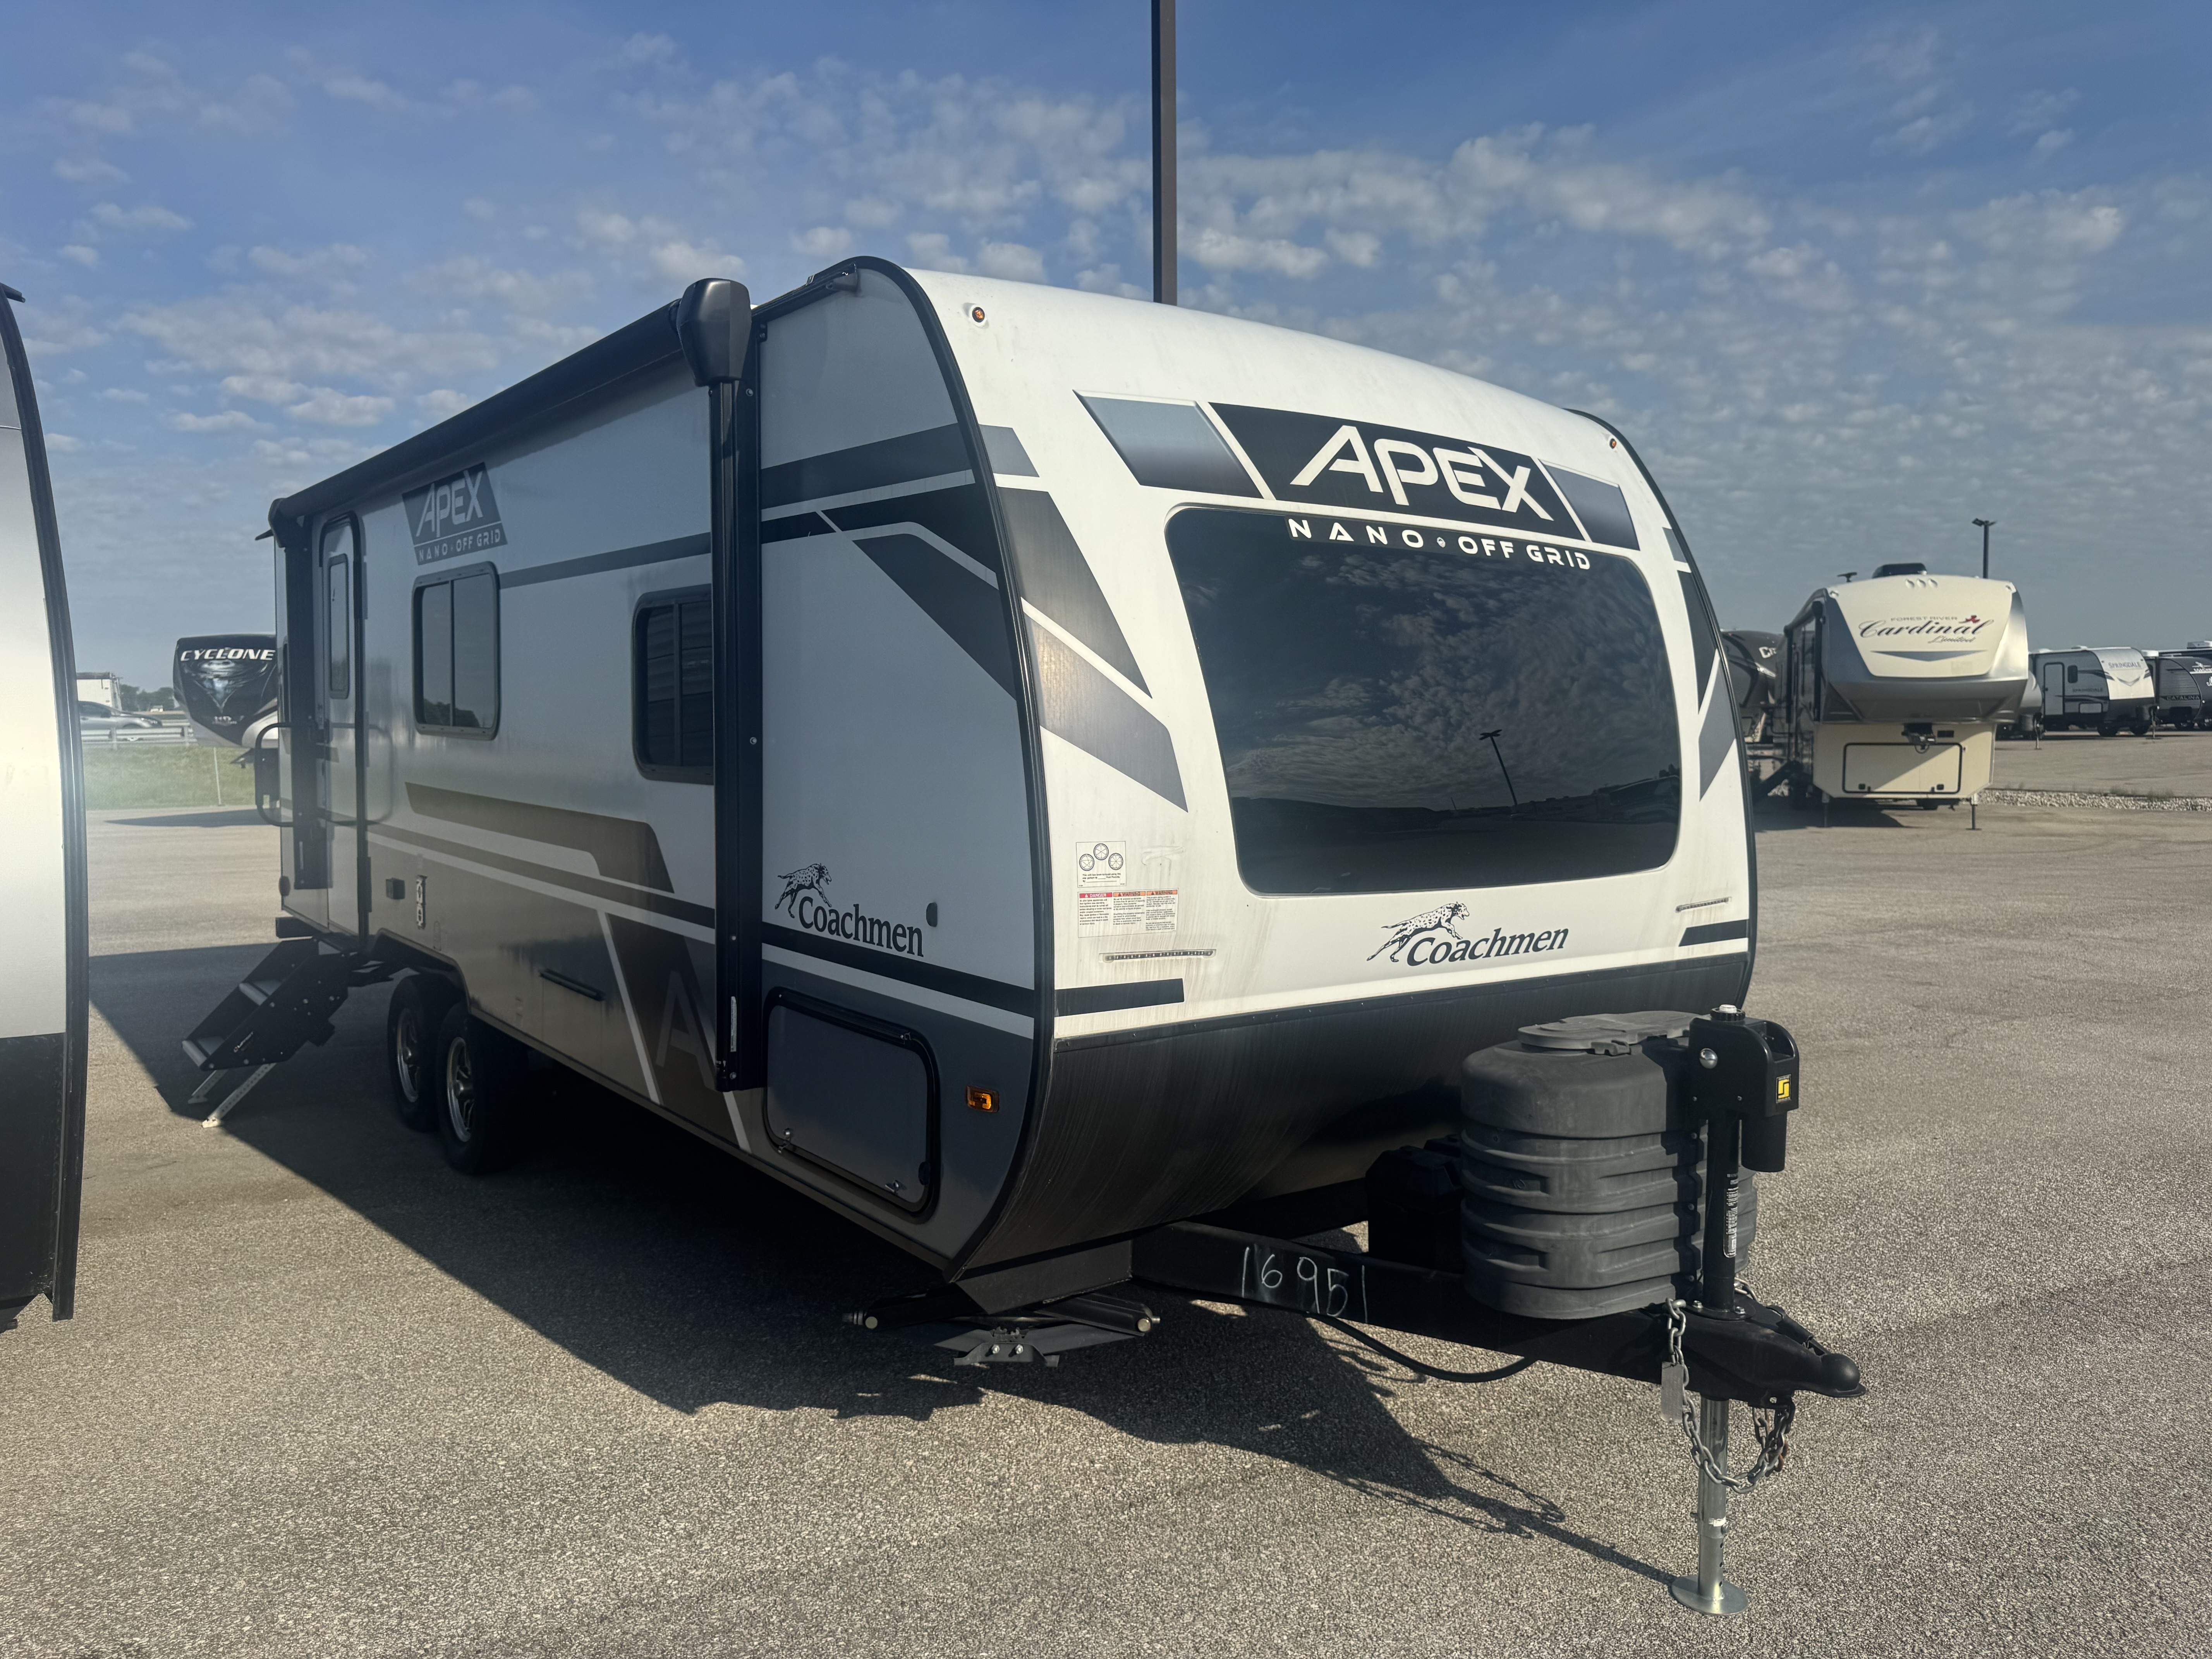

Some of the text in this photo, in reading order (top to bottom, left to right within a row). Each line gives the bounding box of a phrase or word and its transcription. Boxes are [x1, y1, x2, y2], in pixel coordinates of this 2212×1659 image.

[1290, 425, 1554, 521] APEX
[416, 470, 483, 538] APEX
[419, 529, 500, 562] NANO OFF GRID
[1288, 519, 1590, 570] NANO OFF GRID
[1858, 620, 1994, 638] Cardinal
[1927, 635, 1976, 644] Limited
[180, 648, 276, 661] CYCLONE
[799, 896, 924, 957] Coachmen
[1407, 927, 1569, 966] Coachmen
